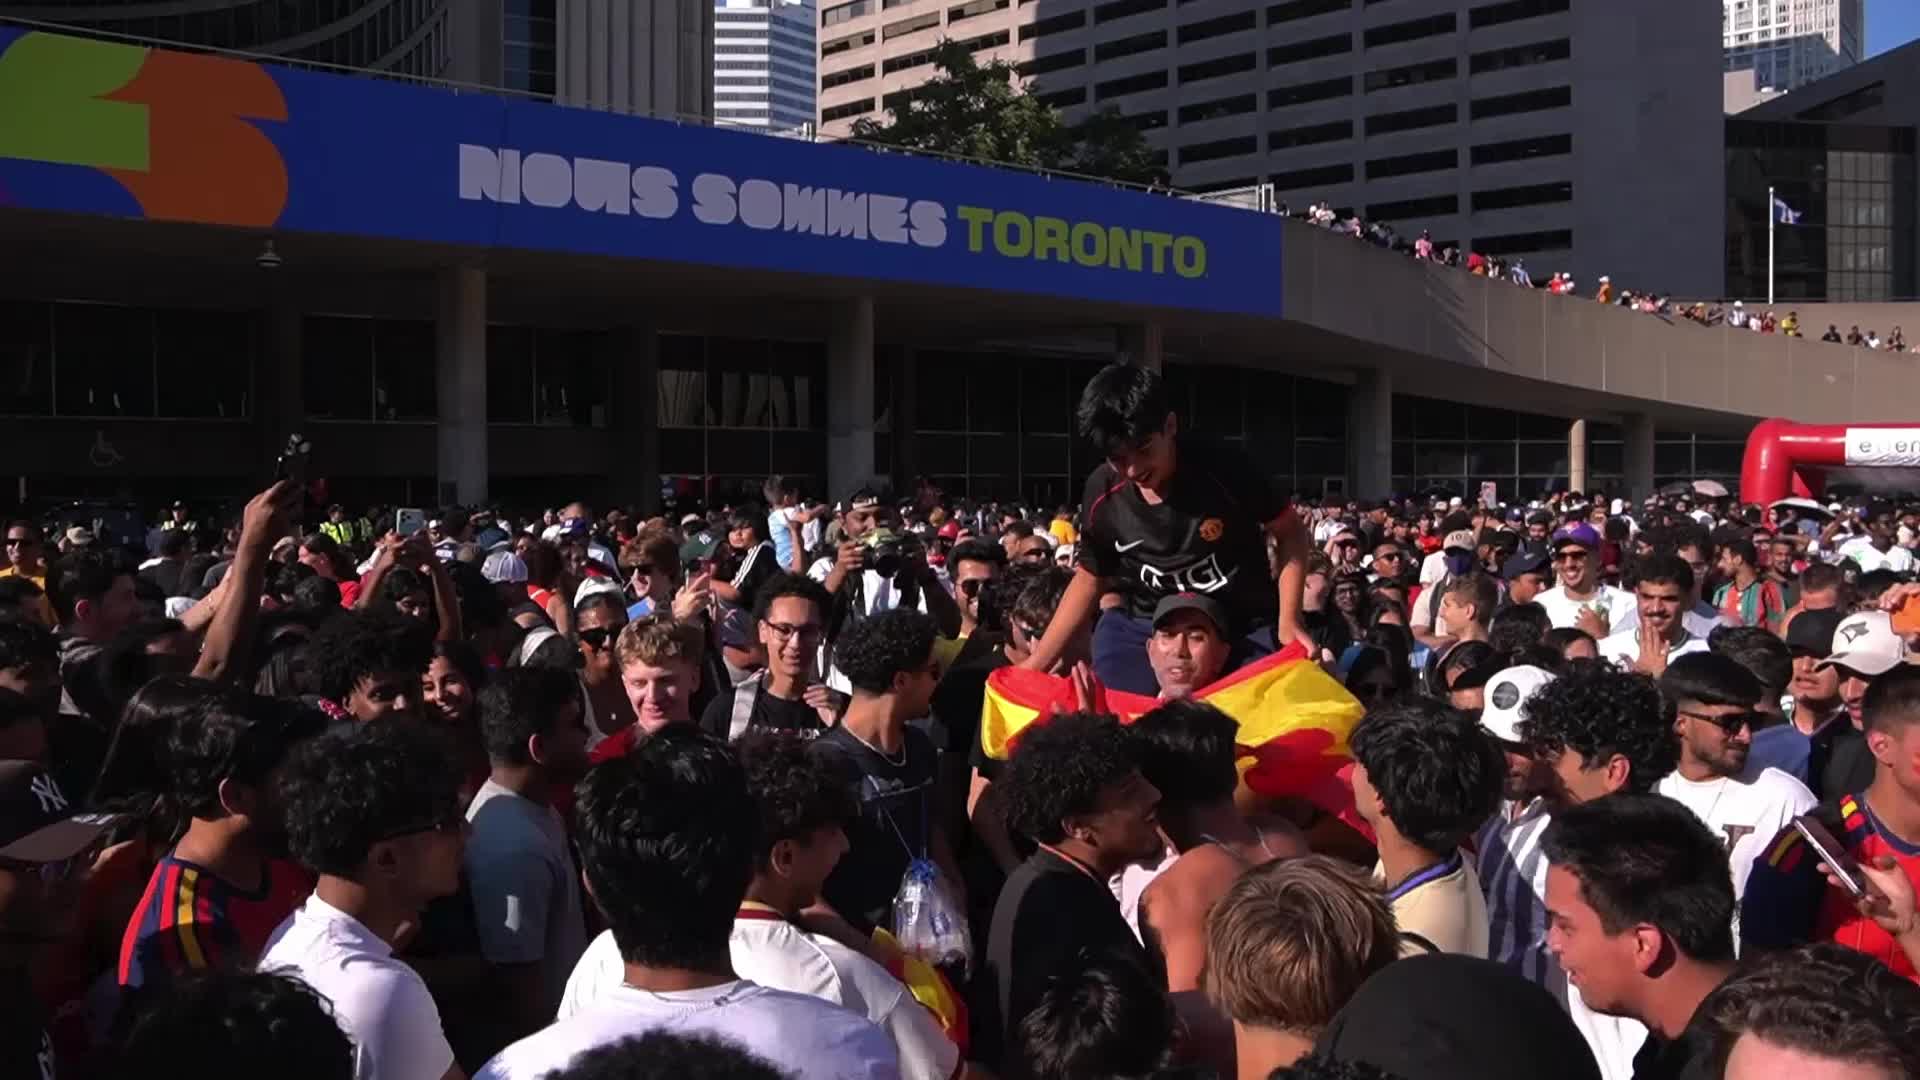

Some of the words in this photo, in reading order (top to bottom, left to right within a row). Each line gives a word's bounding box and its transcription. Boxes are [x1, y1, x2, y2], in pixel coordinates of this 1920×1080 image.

[458, 143, 679, 219] NOUS
[692, 173, 947, 247] SOMMES
[957, 205, 1207, 279] TORONTO
[31, 772, 68, 813] NY
